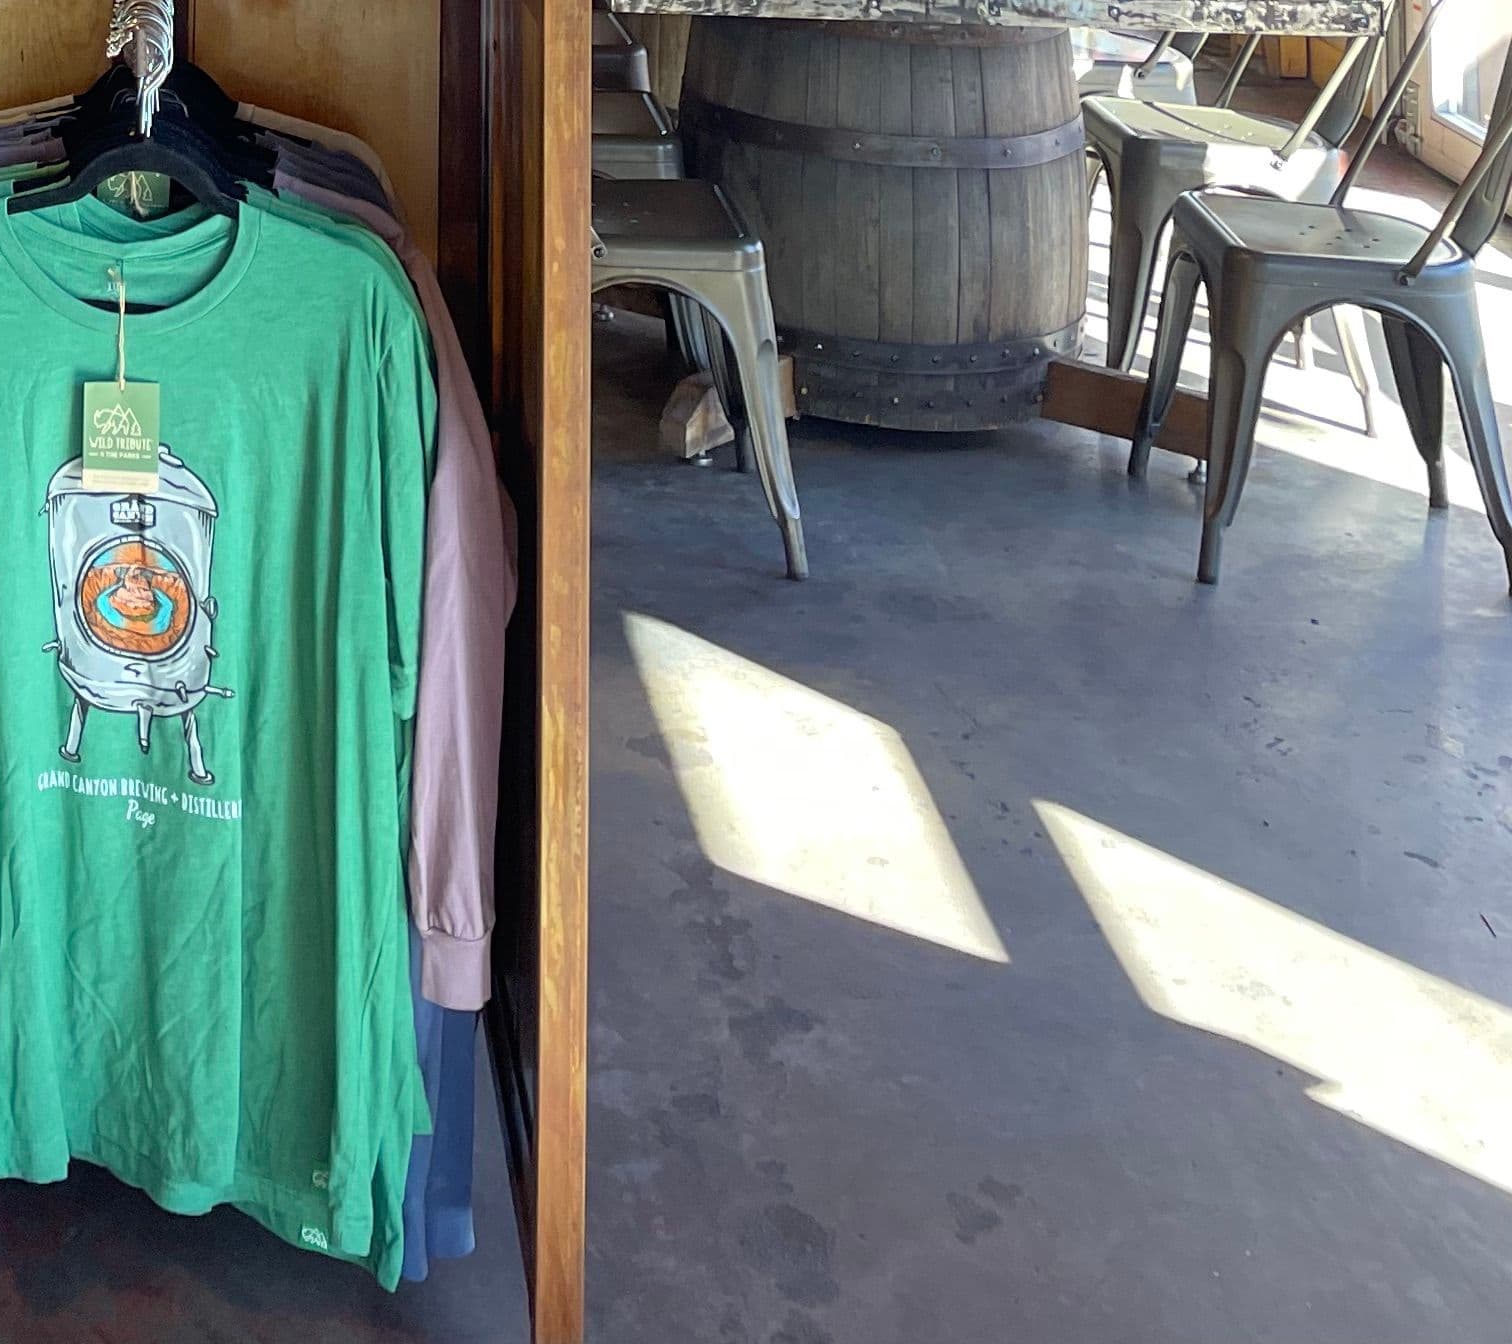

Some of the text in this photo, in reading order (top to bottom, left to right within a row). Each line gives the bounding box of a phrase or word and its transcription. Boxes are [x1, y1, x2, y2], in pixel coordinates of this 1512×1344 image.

[88, 436, 152, 451] WILD TRIBUTE
[37, 769, 71, 792] GRAND
[72, 774, 118, 797] CANYON
[120, 777, 169, 806] BREWING
[181, 792, 243, 820] DISTILLER
[126, 798, 157, 828] Page
